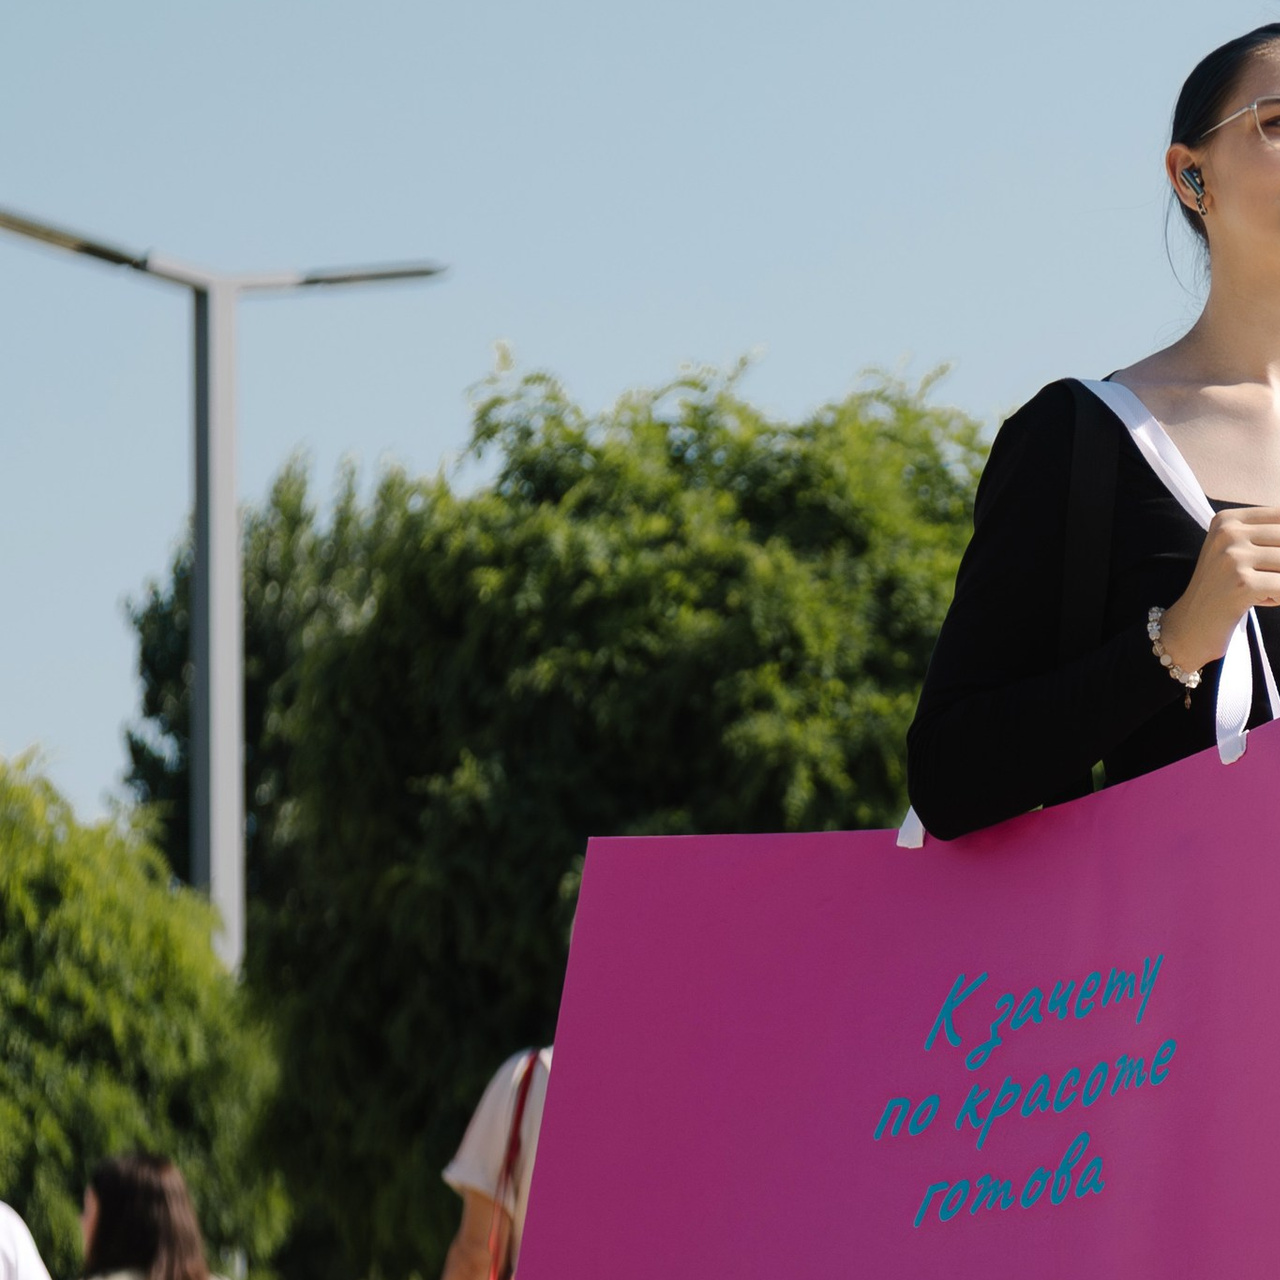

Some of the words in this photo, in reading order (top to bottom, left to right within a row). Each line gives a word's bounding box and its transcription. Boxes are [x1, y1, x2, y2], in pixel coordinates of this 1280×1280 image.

[924, 972, 989, 1051] К
[966, 954, 1164, 1070] зачету
[873, 1095, 941, 1141] по
[955, 1039, 1177, 1150] красоте
[914, 1132, 1106, 1228] готова
